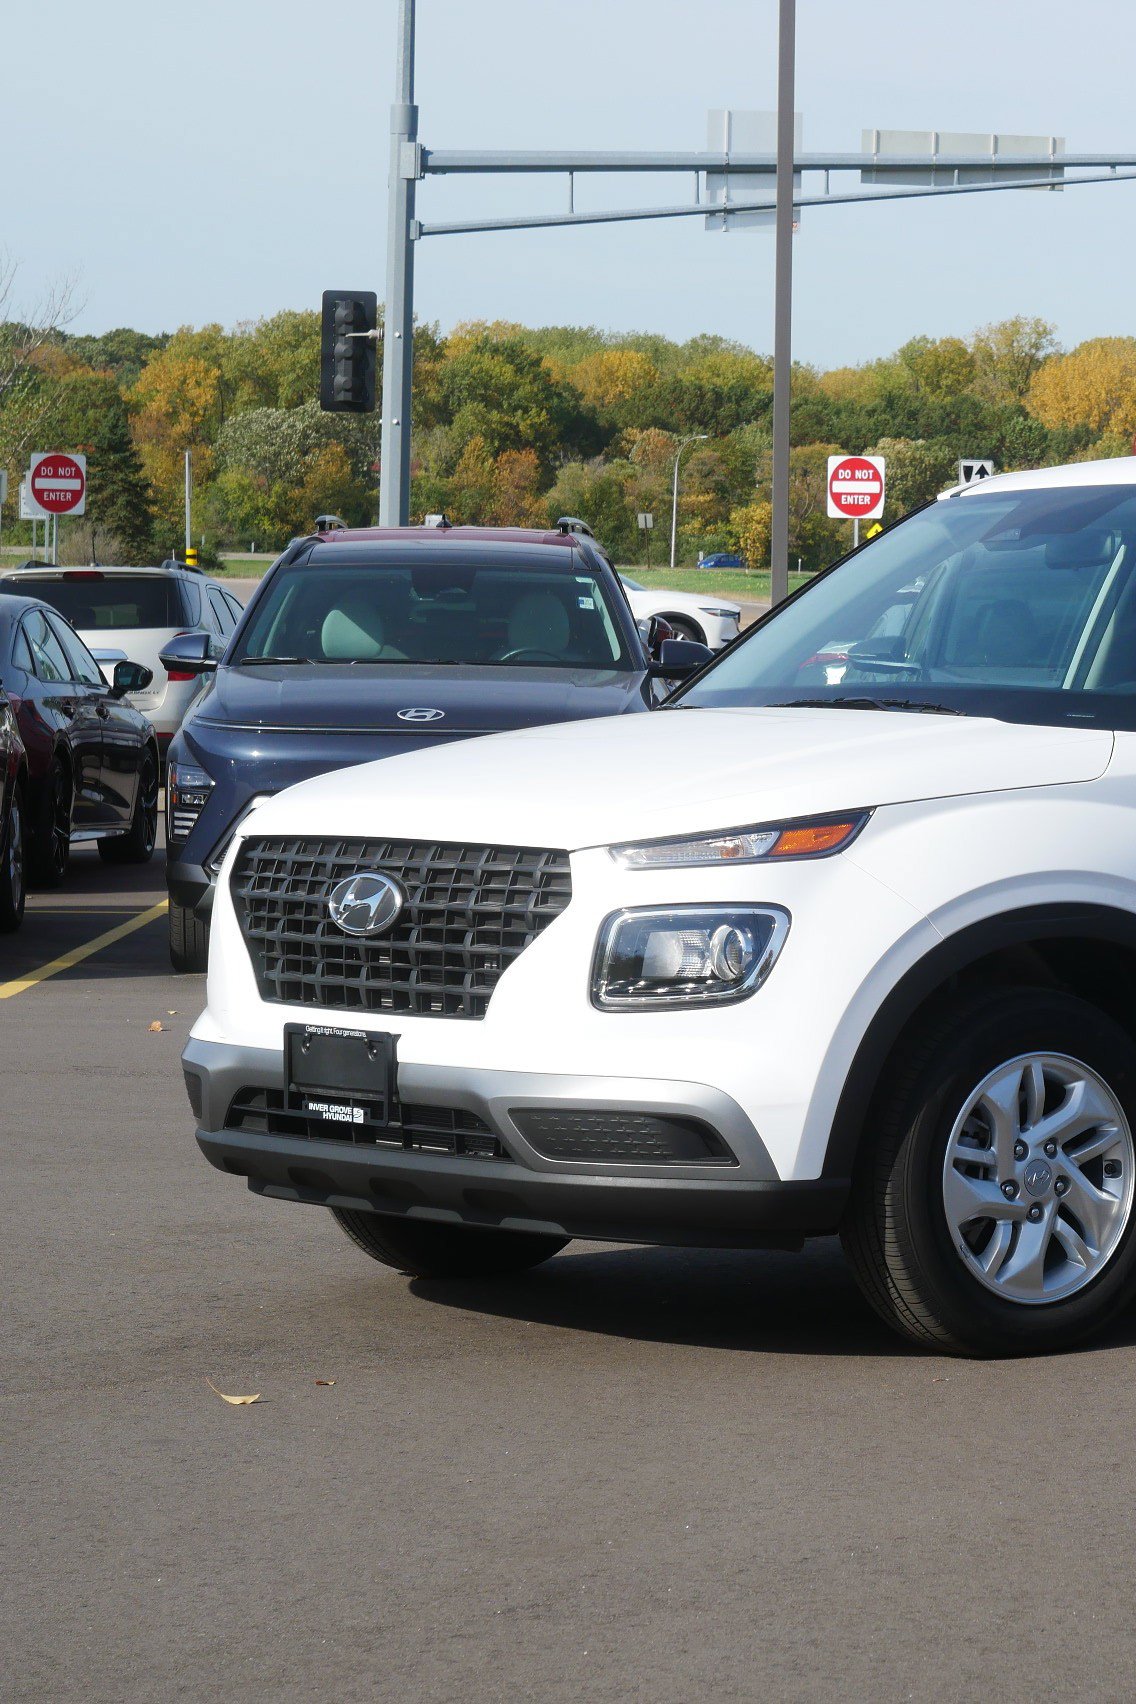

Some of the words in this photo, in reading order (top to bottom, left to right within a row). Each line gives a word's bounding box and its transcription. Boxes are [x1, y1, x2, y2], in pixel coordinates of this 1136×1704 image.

[41, 466, 53, 477] DO
[58, 466, 76, 477] NOT
[838, 469, 852, 479] DO
[855, 469, 874, 479] NOT
[43, 491, 72, 502] ENTER
[841, 494, 871, 505] ENTER
[305, 1025, 321, 1034] Getting
[308, 1102, 329, 1112] INVER
[329, 1105, 353, 1115] GROVE
[322, 1112, 353, 1122] HYUNDAI
